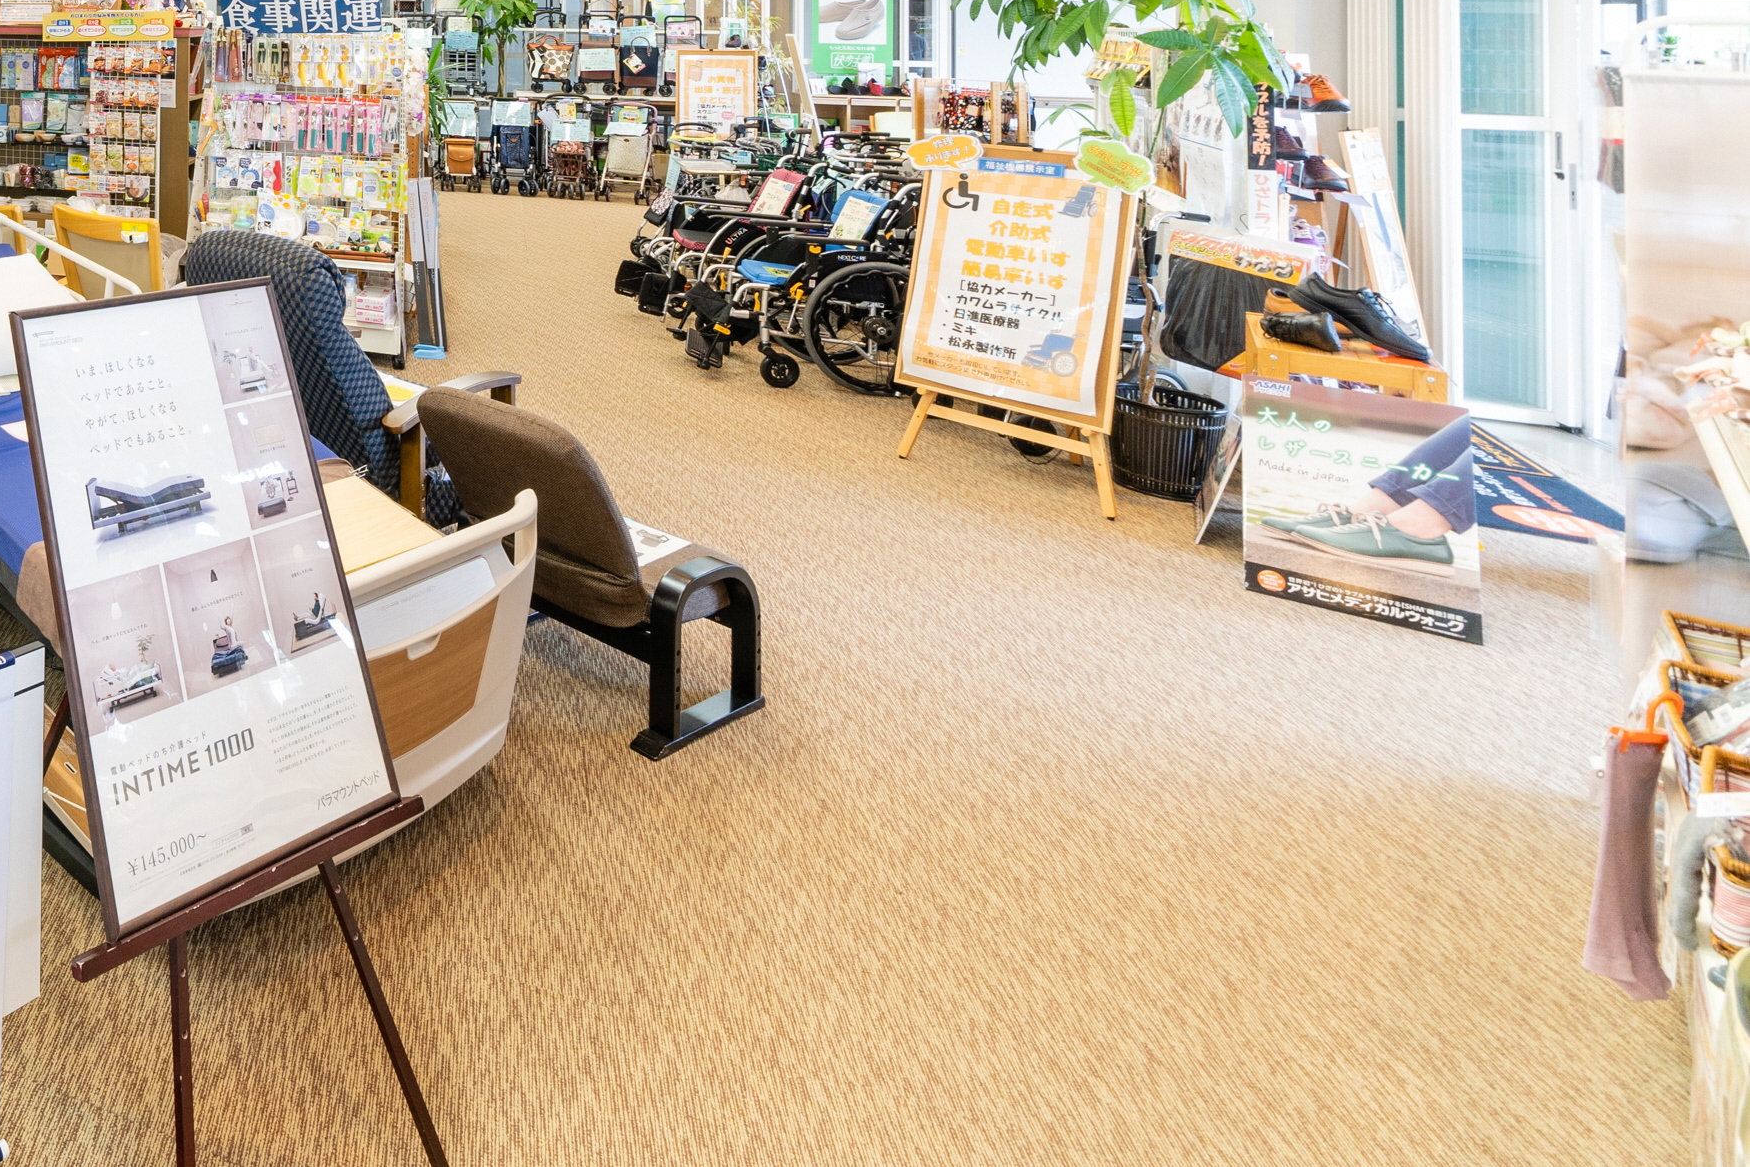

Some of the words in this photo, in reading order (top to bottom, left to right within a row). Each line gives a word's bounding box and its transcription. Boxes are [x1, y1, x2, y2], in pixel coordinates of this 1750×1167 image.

[924, 145, 970, 164] 承ります！
[932, 136, 954, 148] 修理
[985, 161, 1056, 176] 福祉機器展示室
[991, 198, 1055, 221] 自走式
[725, 228, 748, 245] ULTRA
[989, 220, 1052, 243] 介助式
[965, 238, 1070, 268] 電動車いす
[961, 259, 1068, 290] 簡易車いす
[39, 338, 72, 348] PARAMOUNT
[76, 355, 155, 378] いま、ほしくなる
[81, 378, 172, 402] ベッドであること。
[1255, 380, 1291, 391] ASAHI
[85, 401, 177, 430] やがて、ほしくなる
[1257, 407, 1332, 433] 大人の
[90, 425, 192, 454] ベッドでもあること。
[1258, 436, 1461, 482] レザースニーカー
[1259, 459, 1292, 474] Made
[1297, 464, 1309, 476] in
[1313, 469, 1349, 484] japan
[1288, 581, 1465, 633] アサヒメディカルウォーク
[110, 731, 207, 776] 電動ベッドのち介護ベッド
[112, 750, 201, 806] INTIME
[204, 728, 255, 767] 1000
[317, 770, 380, 810] パラマウントベッド
